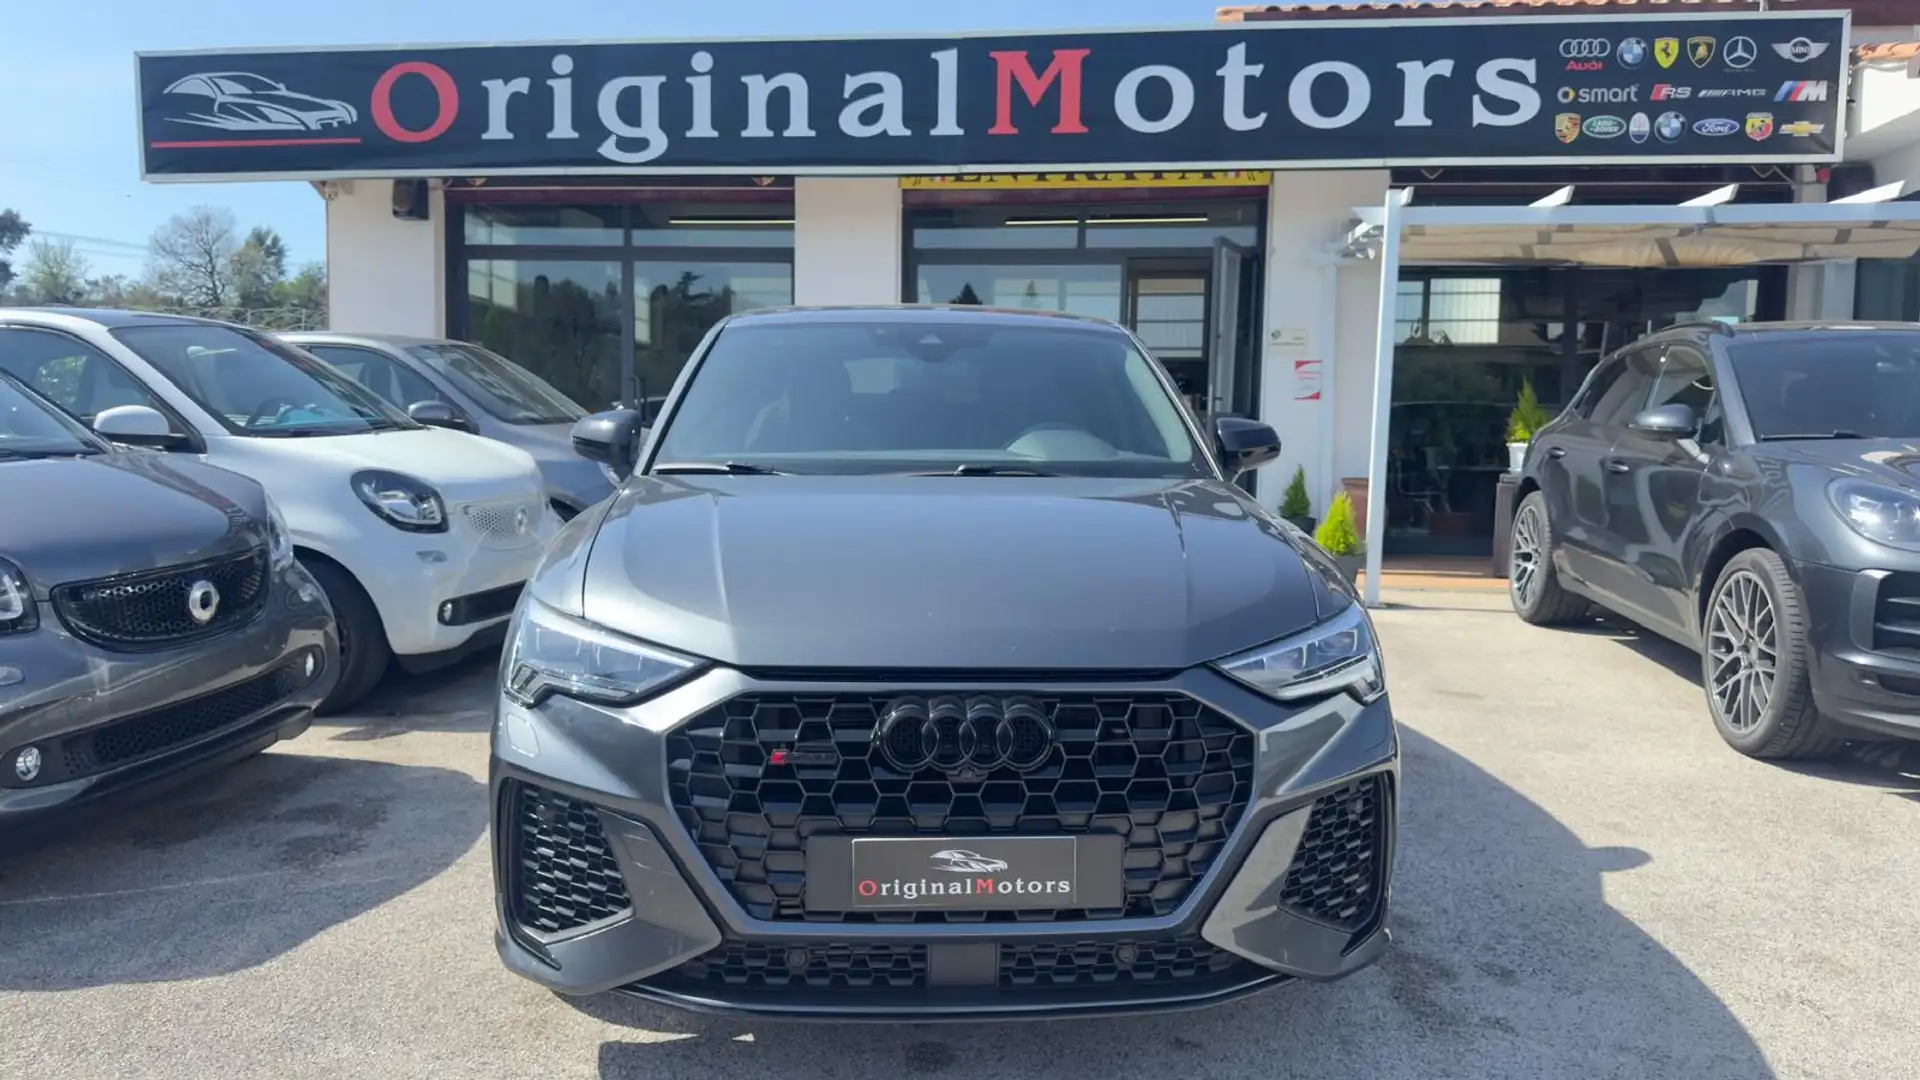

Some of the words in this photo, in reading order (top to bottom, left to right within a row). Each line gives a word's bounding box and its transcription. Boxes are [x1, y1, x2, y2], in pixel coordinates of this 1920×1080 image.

[1565, 60, 1604, 72] Audi
[1578, 85, 1639, 103] smart
[1659, 86, 1692, 99] RS
[1721, 88, 1767, 97] AMG
[370, 42, 1542, 163] OriginalMotors
[858, 878, 1071, 899] OriginalMotors
